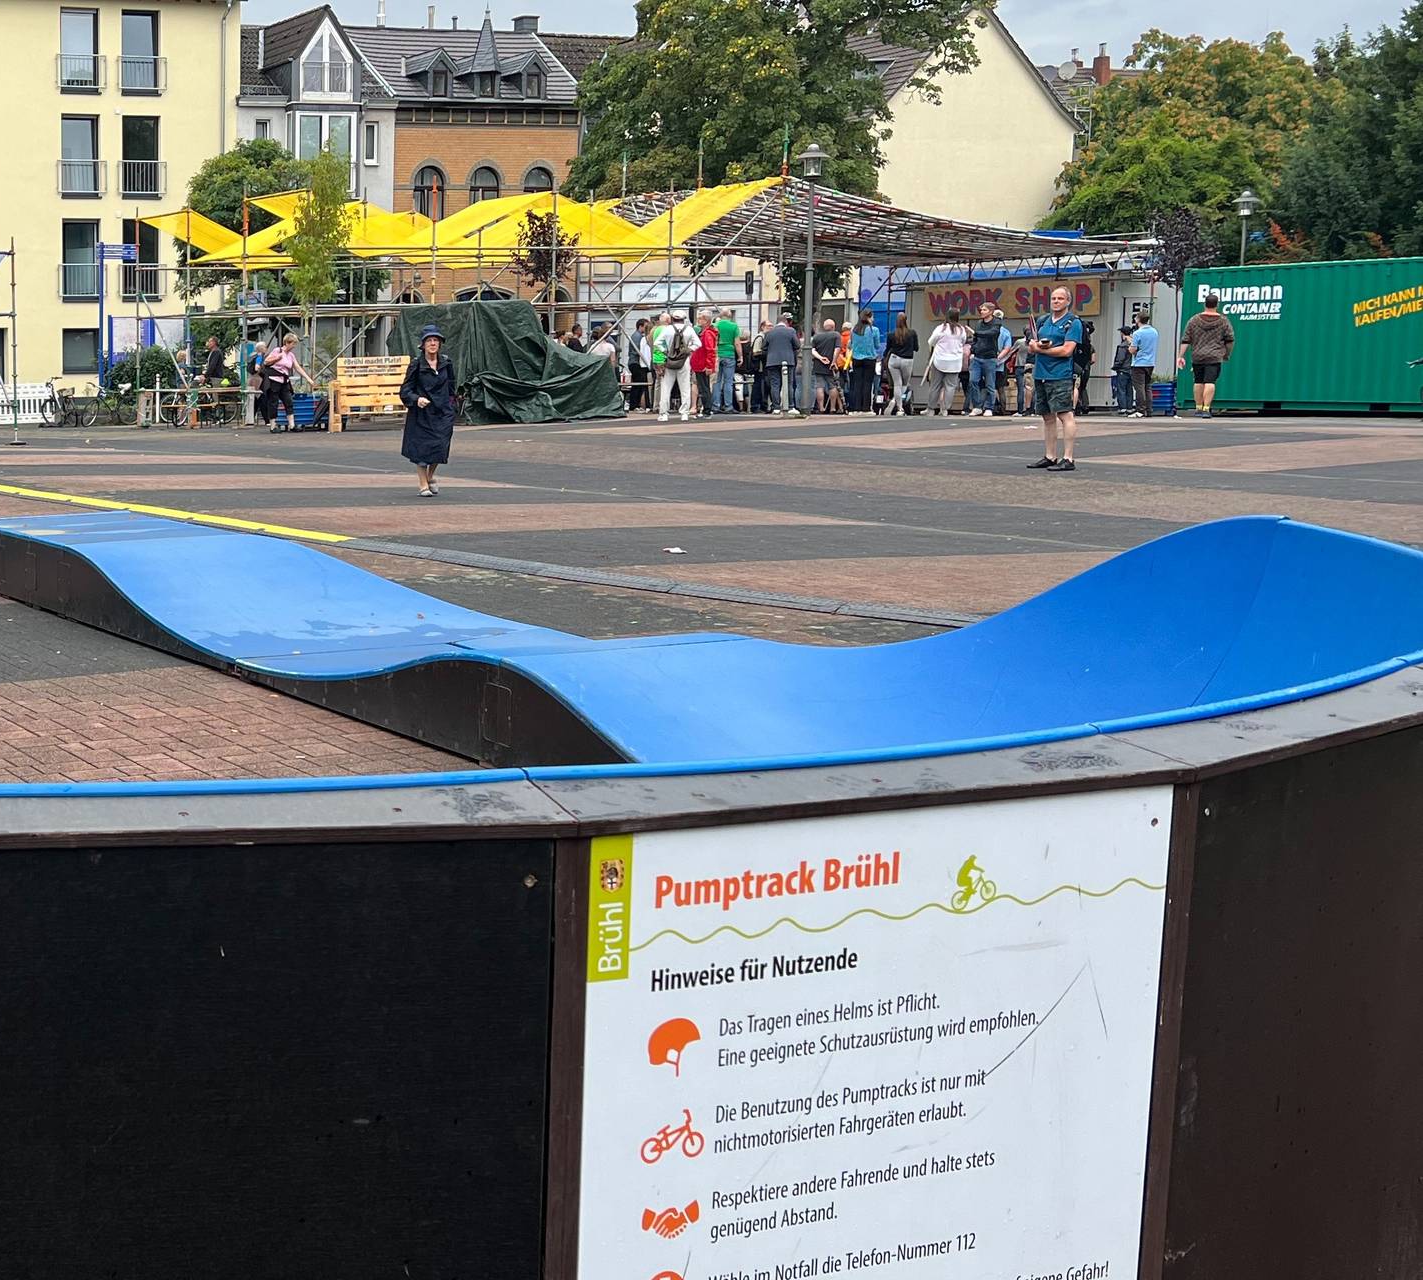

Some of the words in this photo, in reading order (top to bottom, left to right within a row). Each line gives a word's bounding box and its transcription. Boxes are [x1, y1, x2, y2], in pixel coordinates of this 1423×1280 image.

[929, 287, 1003, 316] WORK
[1015, 283, 1094, 312] SHP
[1198, 284, 1283, 302] Baumann
[1222, 302, 1282, 315] CONTAINER
[1353, 297, 1380, 315] MICH
[1383, 287, 1416, 306] KANN
[1355, 299, 1423, 327] KAUFEN/MIE
[655, 861, 816, 910] Pumptrack
[823, 852, 900, 892] Brühl
[598, 901, 624, 972] Brühl
[651, 963, 735, 991] Hinweise
[740, 959, 768, 981] für
[772, 948, 858, 978] Nutzende
[720, 1017, 743, 1037] Das
[748, 1012, 791, 1036] Tragen
[796, 1010, 829, 1026] eines
[833, 1002, 873, 1023] Helms
[878, 999, 892, 1017] ist
[897, 993, 940, 1014] Pflicht.
[718, 1047, 746, 1067] Eine
[750, 1039, 816, 1068] geeignete
[820, 1024, 933, 1053] Schutzausrüstung
[938, 1018, 965, 1037] wird
[970, 1010, 1039, 1036] empfohlen.
[715, 1105, 736, 1124] Die
[741, 1096, 812, 1120] Benutzung
[816, 1091, 838, 1109] des
[843, 1080, 917, 1106] Pumptracks
[921, 1077, 935, 1093] ist
[940, 1075, 961, 1091] nur
[965, 1070, 985, 1087] mit
[714, 1121, 834, 1153] nichtmotorisierten
[839, 1110, 914, 1135] Fahrgeräten
[919, 1102, 966, 1123] erlaubt.
[712, 1183, 788, 1209] Respektiere
[792, 1176, 837, 1196] andere
[841, 1164, 899, 1188] Fahrende
[903, 1159, 927, 1179] und
[931, 1155, 962, 1174] halte
[966, 1151, 995, 1169] stets
[710, 1212, 776, 1243] genügend
[781, 1202, 837, 1227] Abstand.
[776, 1258, 818, 1280] Notfall
[822, 1256, 842, 1274] die
[846, 1238, 952, 1270] Telefon-Nummer
[956, 1233, 976, 1250] 112
[1066, 1261, 1109, 1280] Gefahr!
